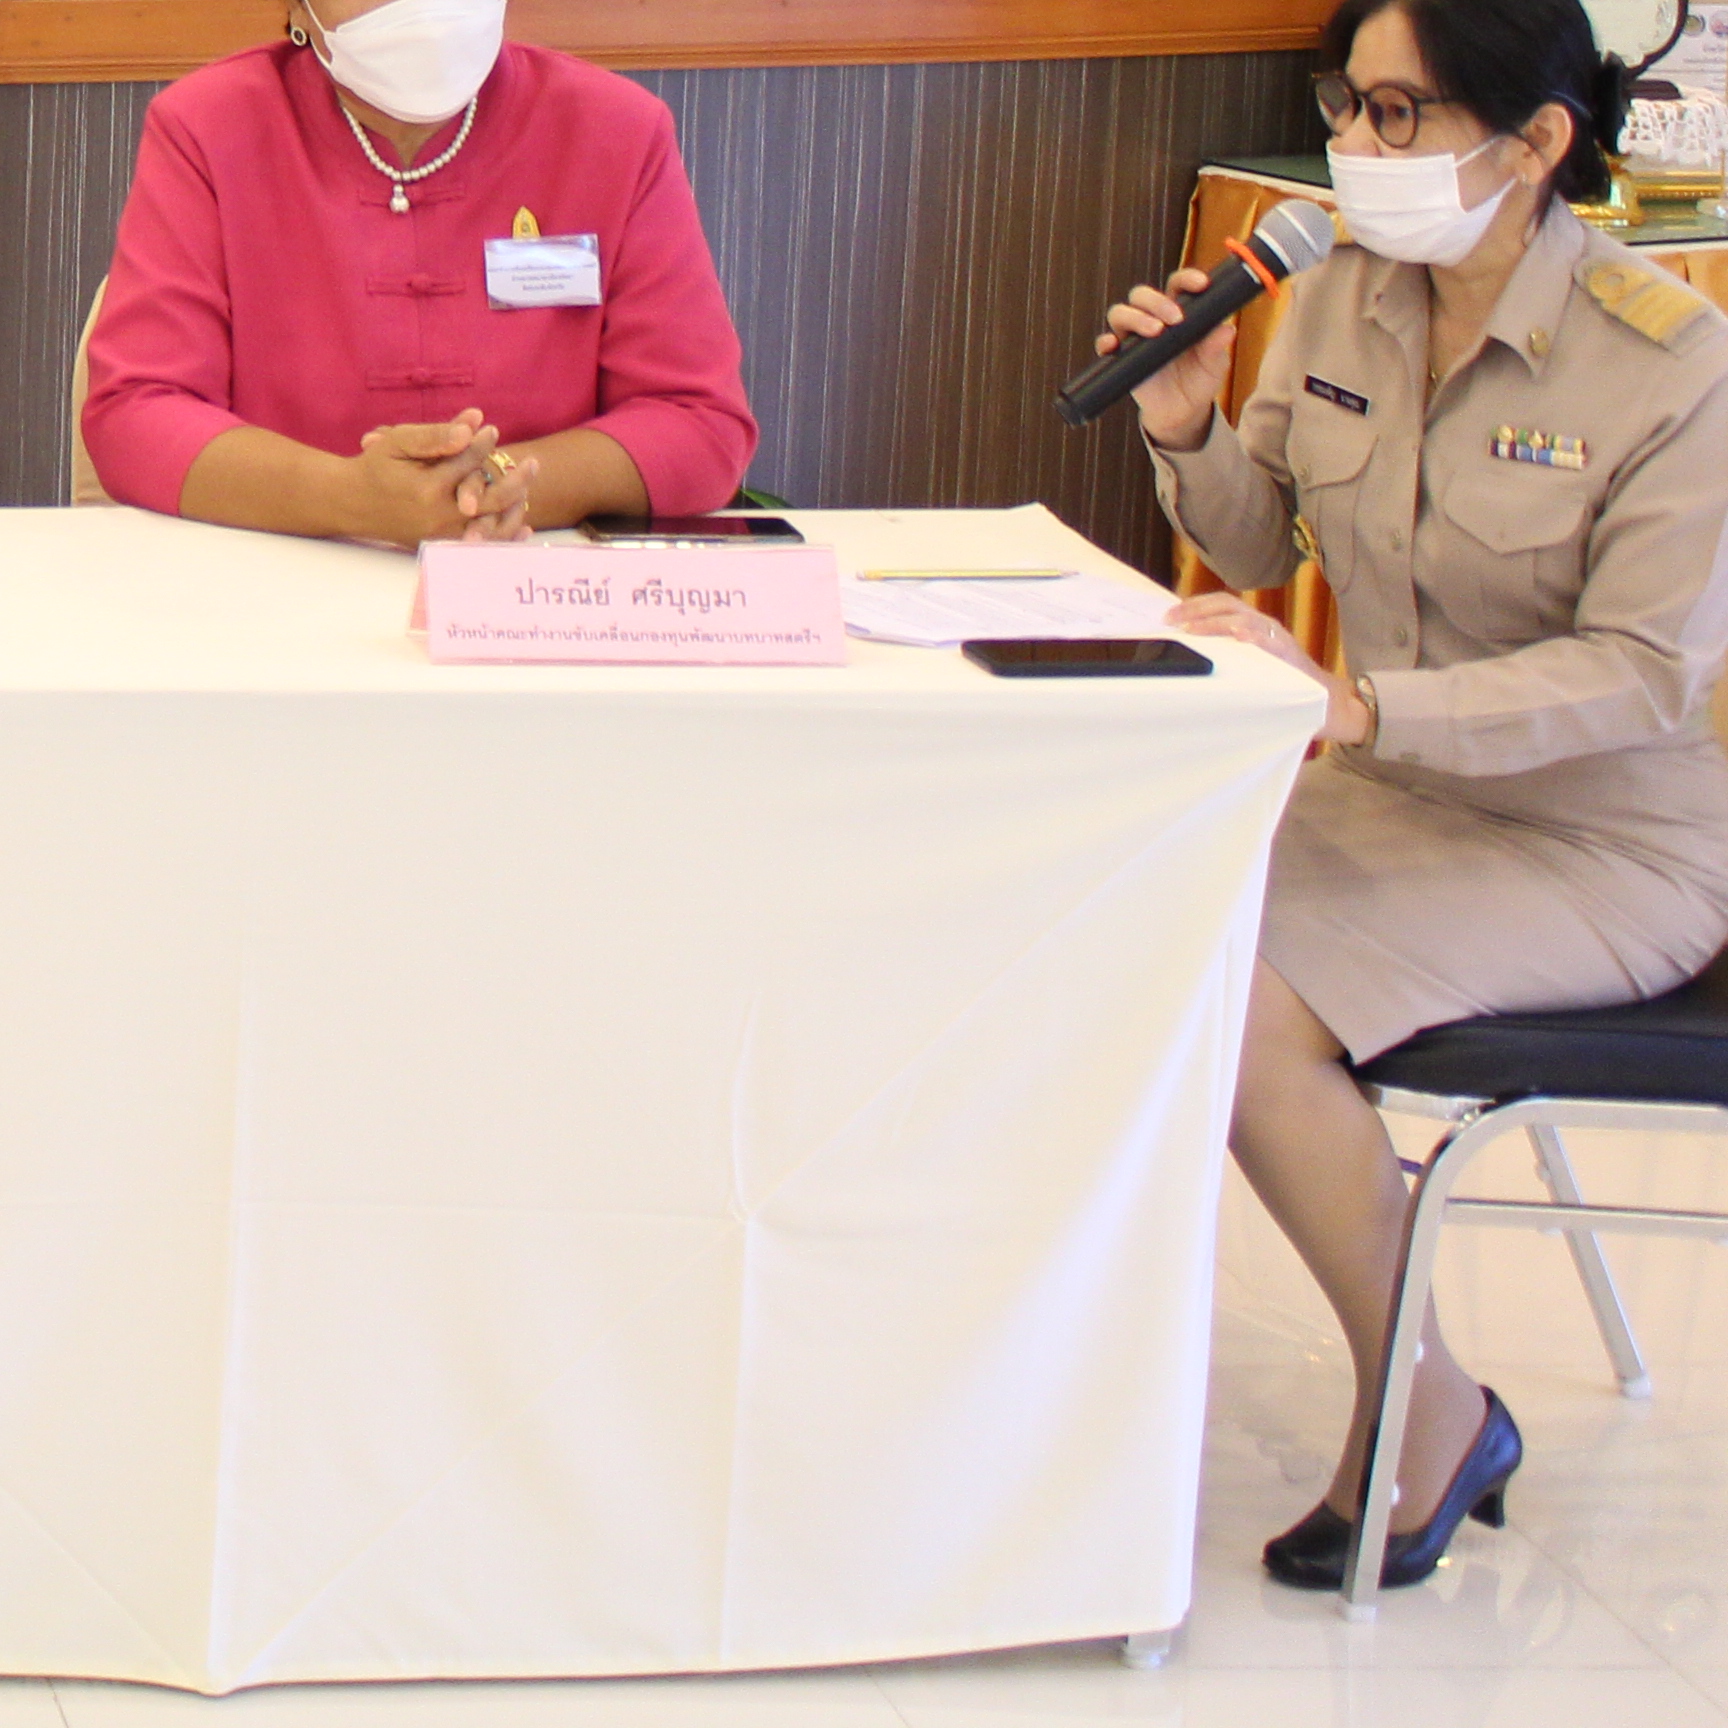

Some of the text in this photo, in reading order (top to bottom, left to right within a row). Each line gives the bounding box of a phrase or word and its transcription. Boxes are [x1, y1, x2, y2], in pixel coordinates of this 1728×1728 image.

[515, 576, 747, 617] ปารณีย์ ศรีบุญมา
